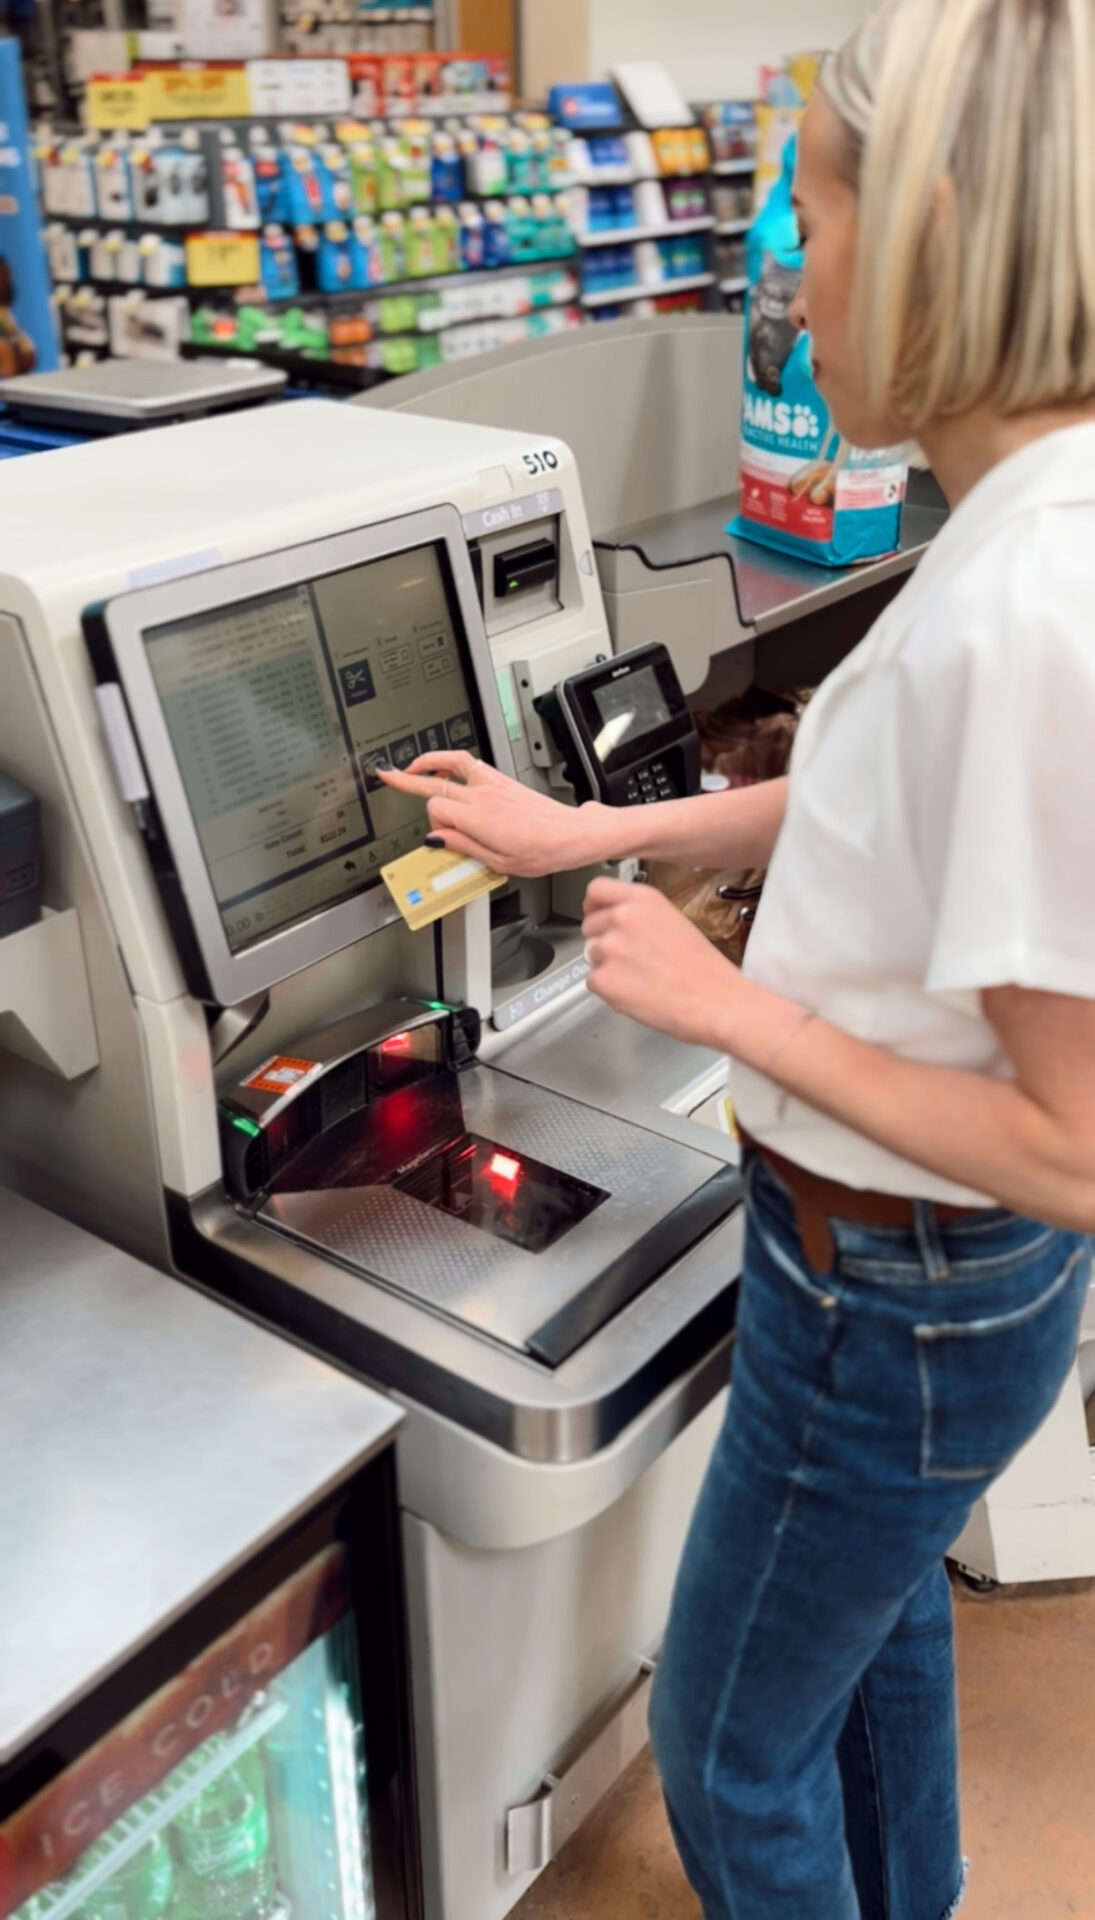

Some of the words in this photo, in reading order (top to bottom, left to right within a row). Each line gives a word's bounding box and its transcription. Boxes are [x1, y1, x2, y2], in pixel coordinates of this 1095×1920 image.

[742, 392, 792, 436] AMS
[522, 450, 558, 475] 510
[482, 505, 510, 527] Cash
[41, 1771, 125, 1859] ICE
[152, 1642, 273, 1758] COLD
